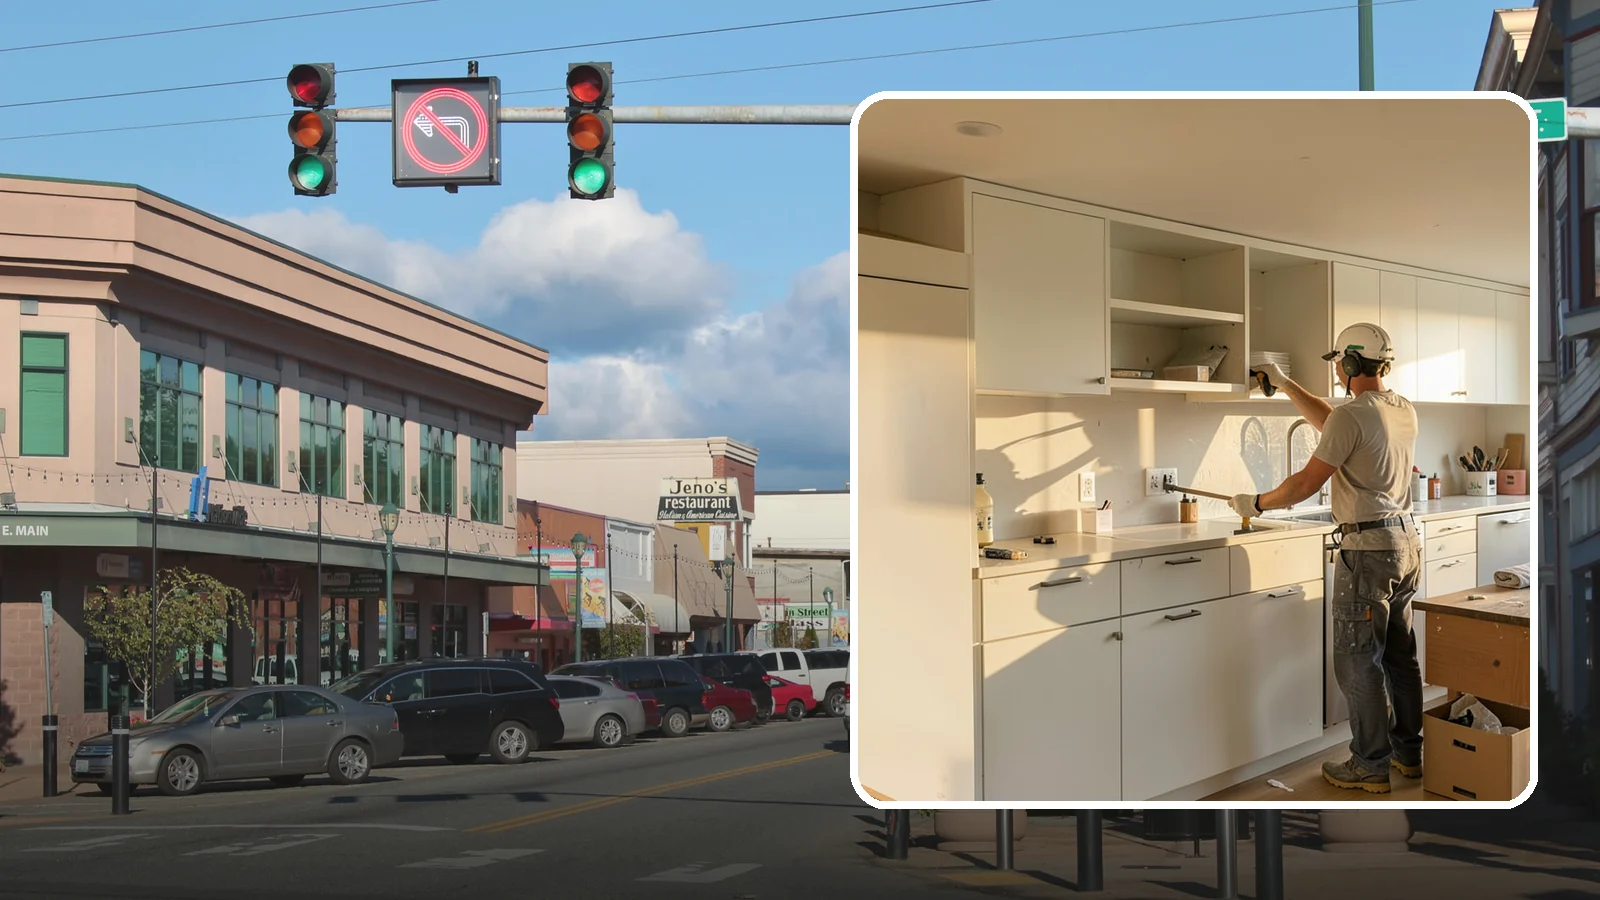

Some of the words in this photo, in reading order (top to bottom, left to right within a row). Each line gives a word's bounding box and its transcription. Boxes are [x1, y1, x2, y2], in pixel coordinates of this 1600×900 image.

[670, 480, 727, 494] Jeno's
[665, 496, 731, 509] restaurant
[658, 510, 681, 519] Italian
[686, 510, 714, 519] American
[715, 510, 737, 519] Cuisine
[2, 525, 13, 536] E.
[15, 525, 49, 536] MAIN
[797, 607, 828, 617] Street
